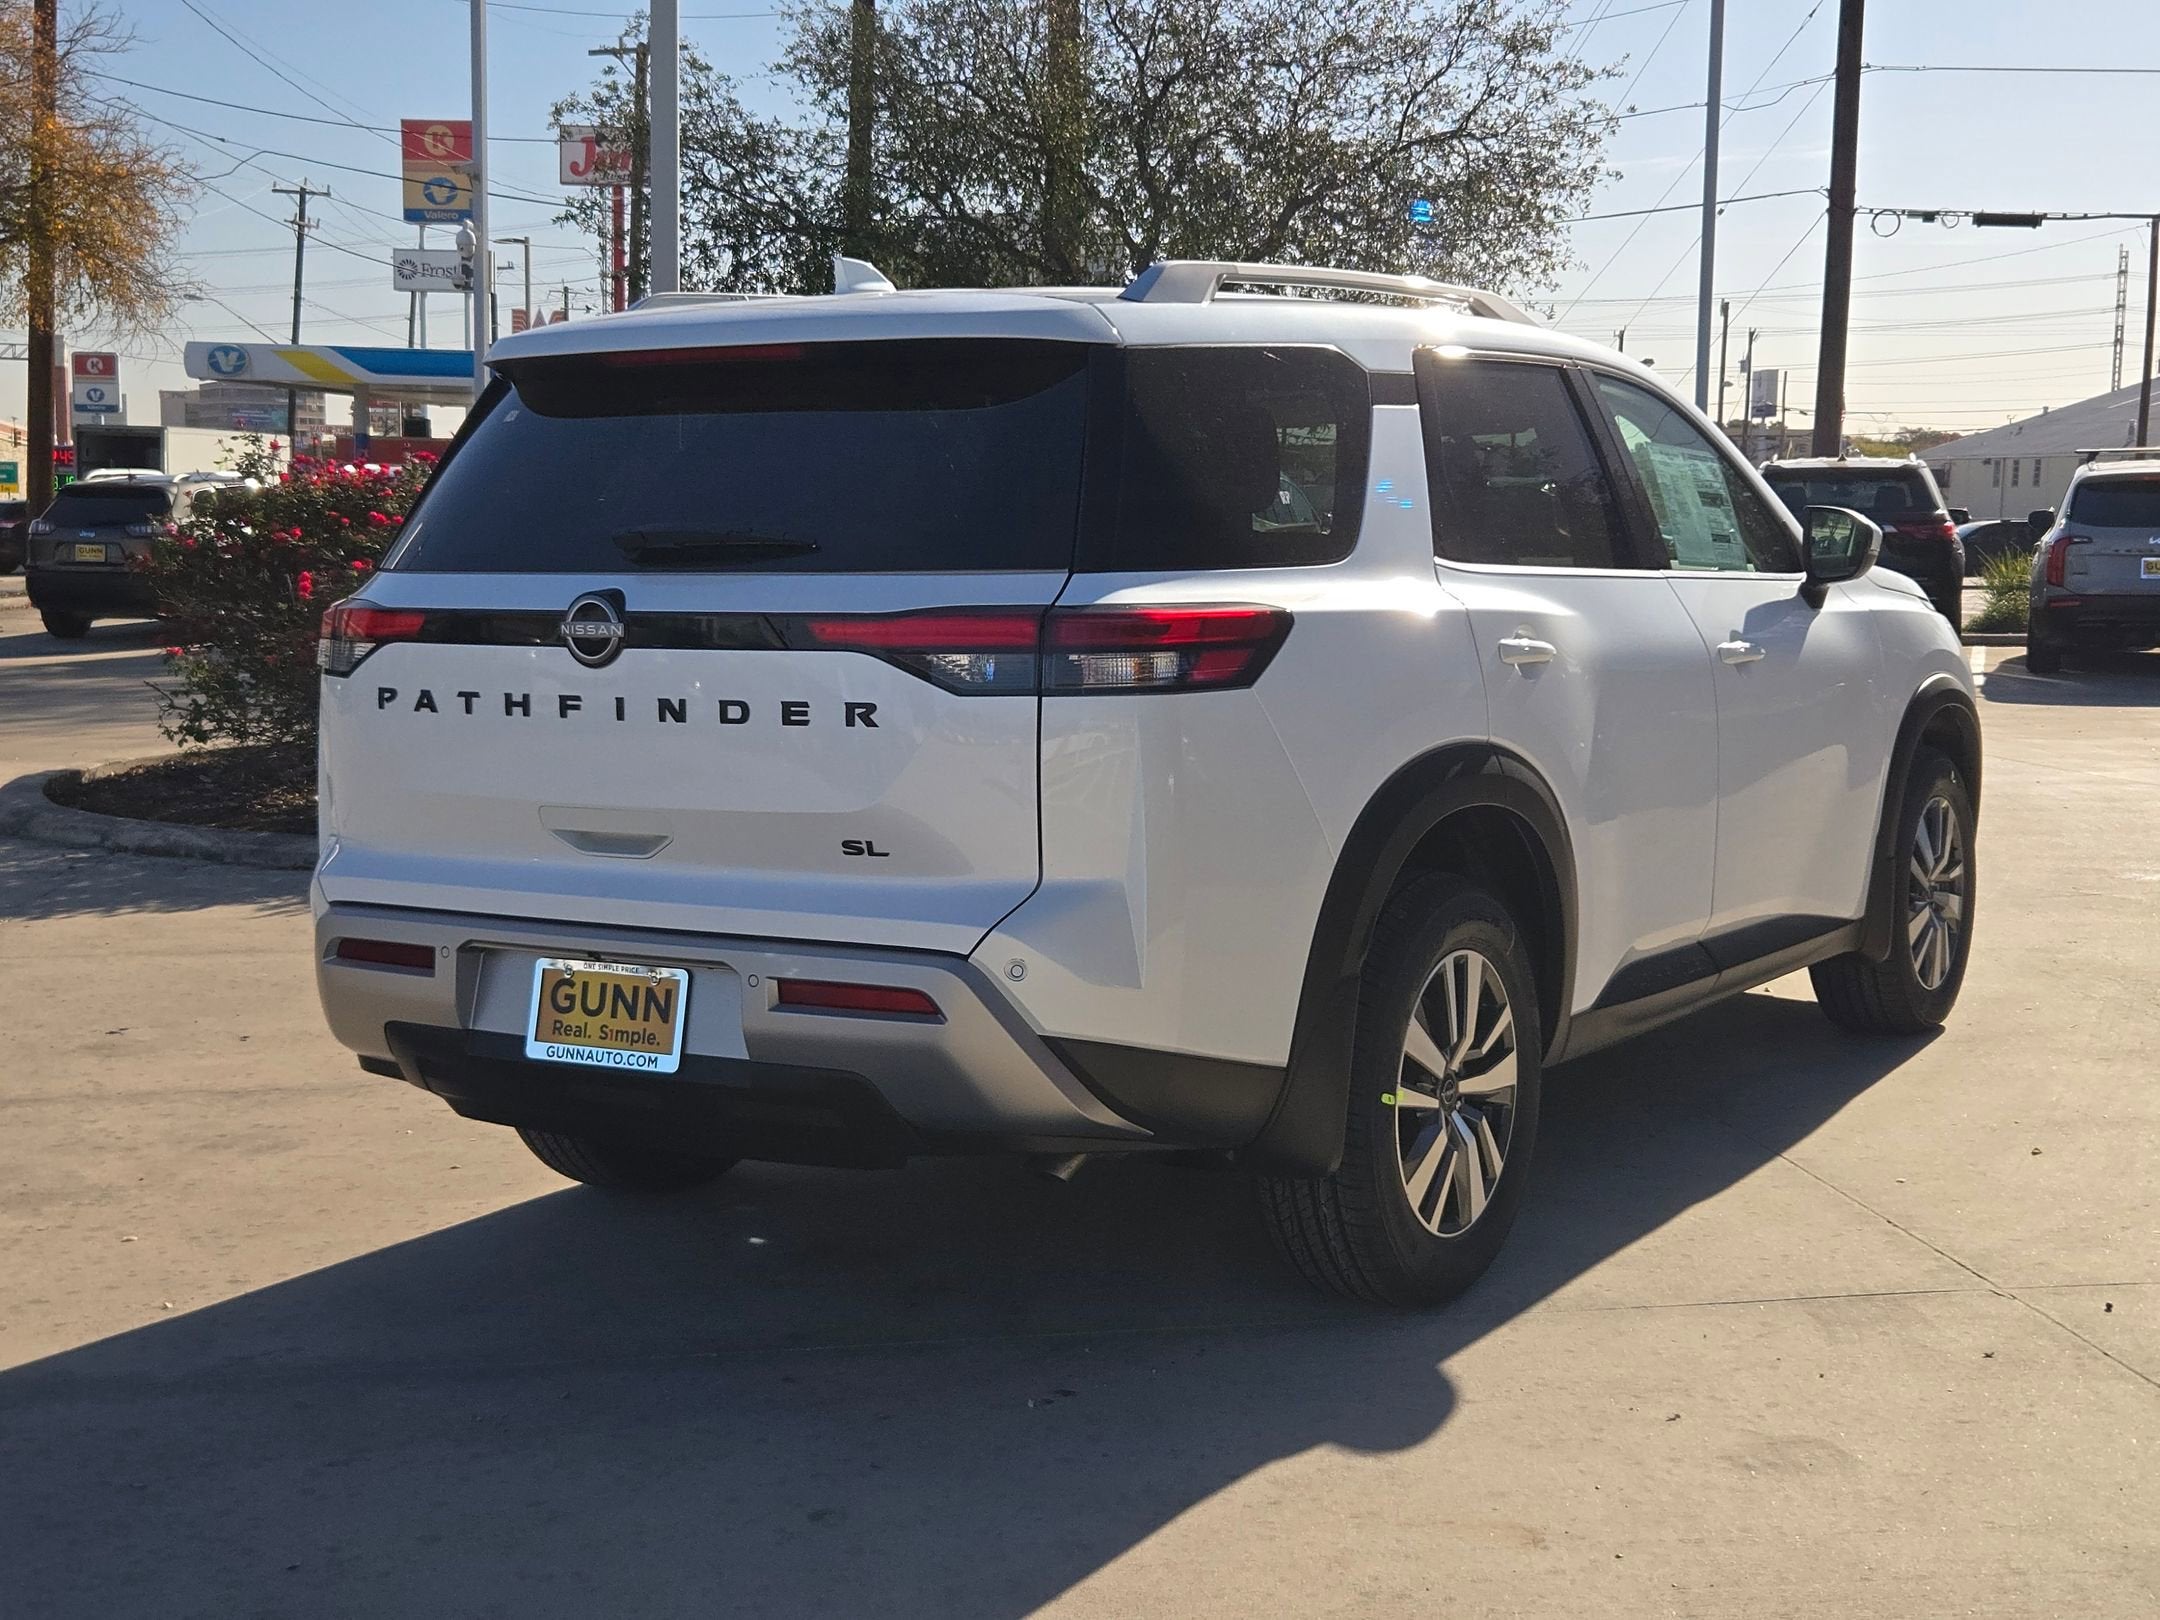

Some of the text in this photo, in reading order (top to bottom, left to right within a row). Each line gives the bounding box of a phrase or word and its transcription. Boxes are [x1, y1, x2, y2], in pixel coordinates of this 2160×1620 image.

[424, 210, 459, 220] Valero
[561, 624, 622, 636] NISSAN
[377, 686, 880, 729] PATHFINDER
[841, 839, 890, 857] SL
[583, 962, 640, 974] ONE SIMPLE PRICE
[550, 977, 673, 1025] GUNN
[552, 1019, 592, 1039] Real.
[546, 1044, 658, 1069] GUNNAUTO.COM
